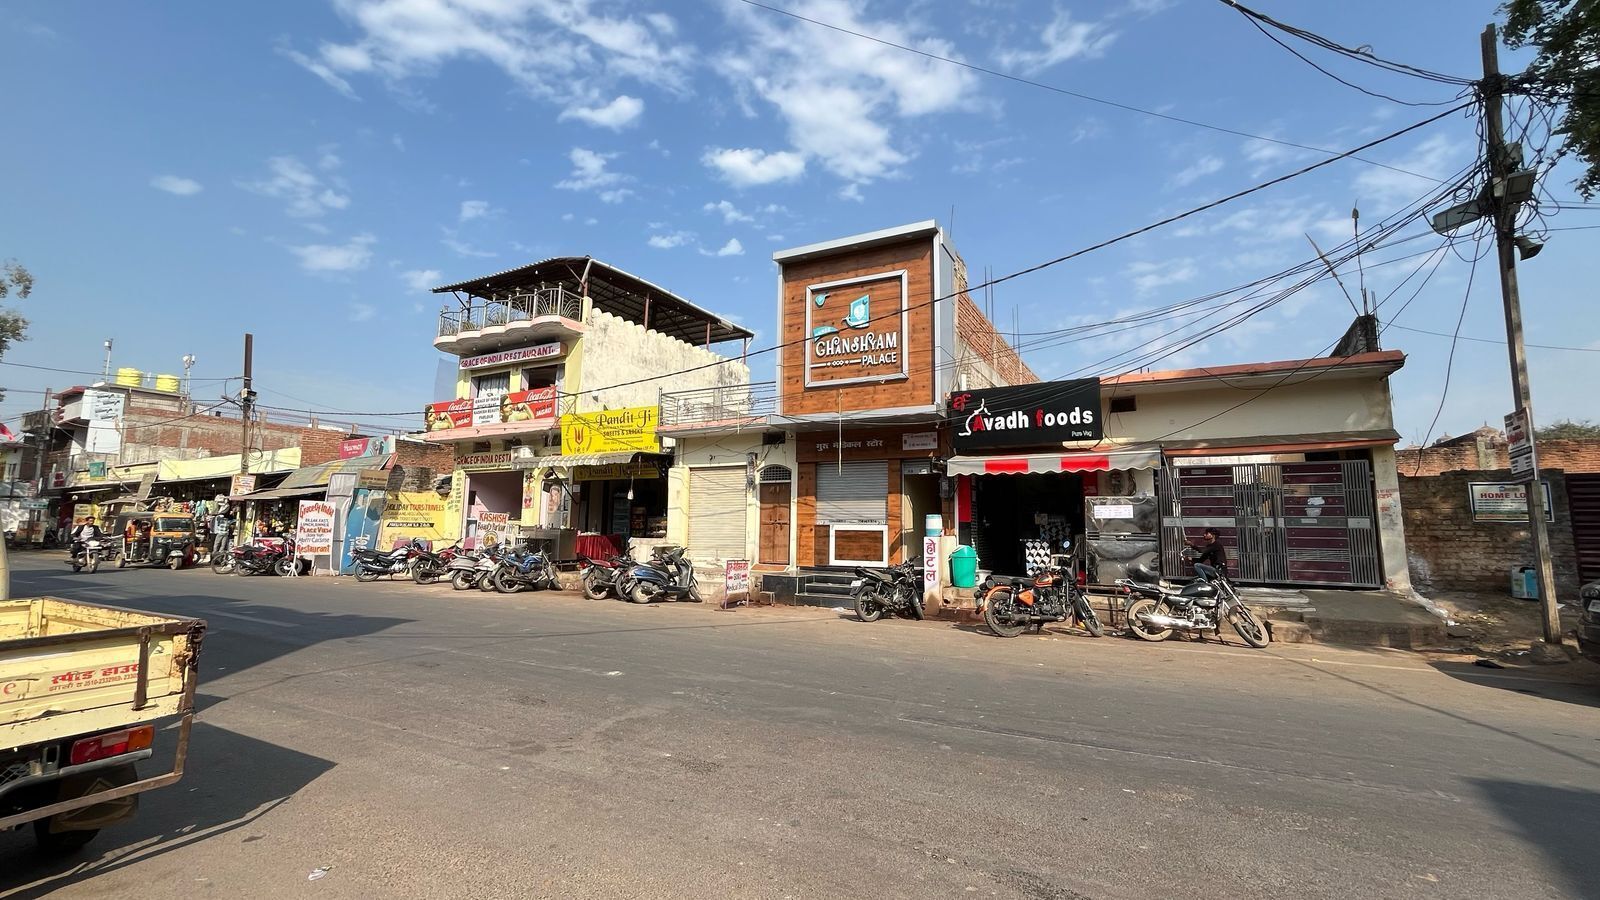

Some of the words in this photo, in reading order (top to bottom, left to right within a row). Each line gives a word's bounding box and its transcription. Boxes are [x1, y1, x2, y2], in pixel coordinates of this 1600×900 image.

[815, 332, 898, 357] GHANSHYAM
[461, 359, 479, 368] GRACE
[487, 354, 503, 364] INDIA
[862, 352, 897, 366] PALACE
[595, 410, 634, 430] Pandit
[637, 409, 651, 428] Ji
[972, 410, 1029, 431] Avadh
[1036, 406, 1094, 427] foods
[385, 503, 409, 511] HOLIDAY
[480, 512, 507, 524] KASHISH
